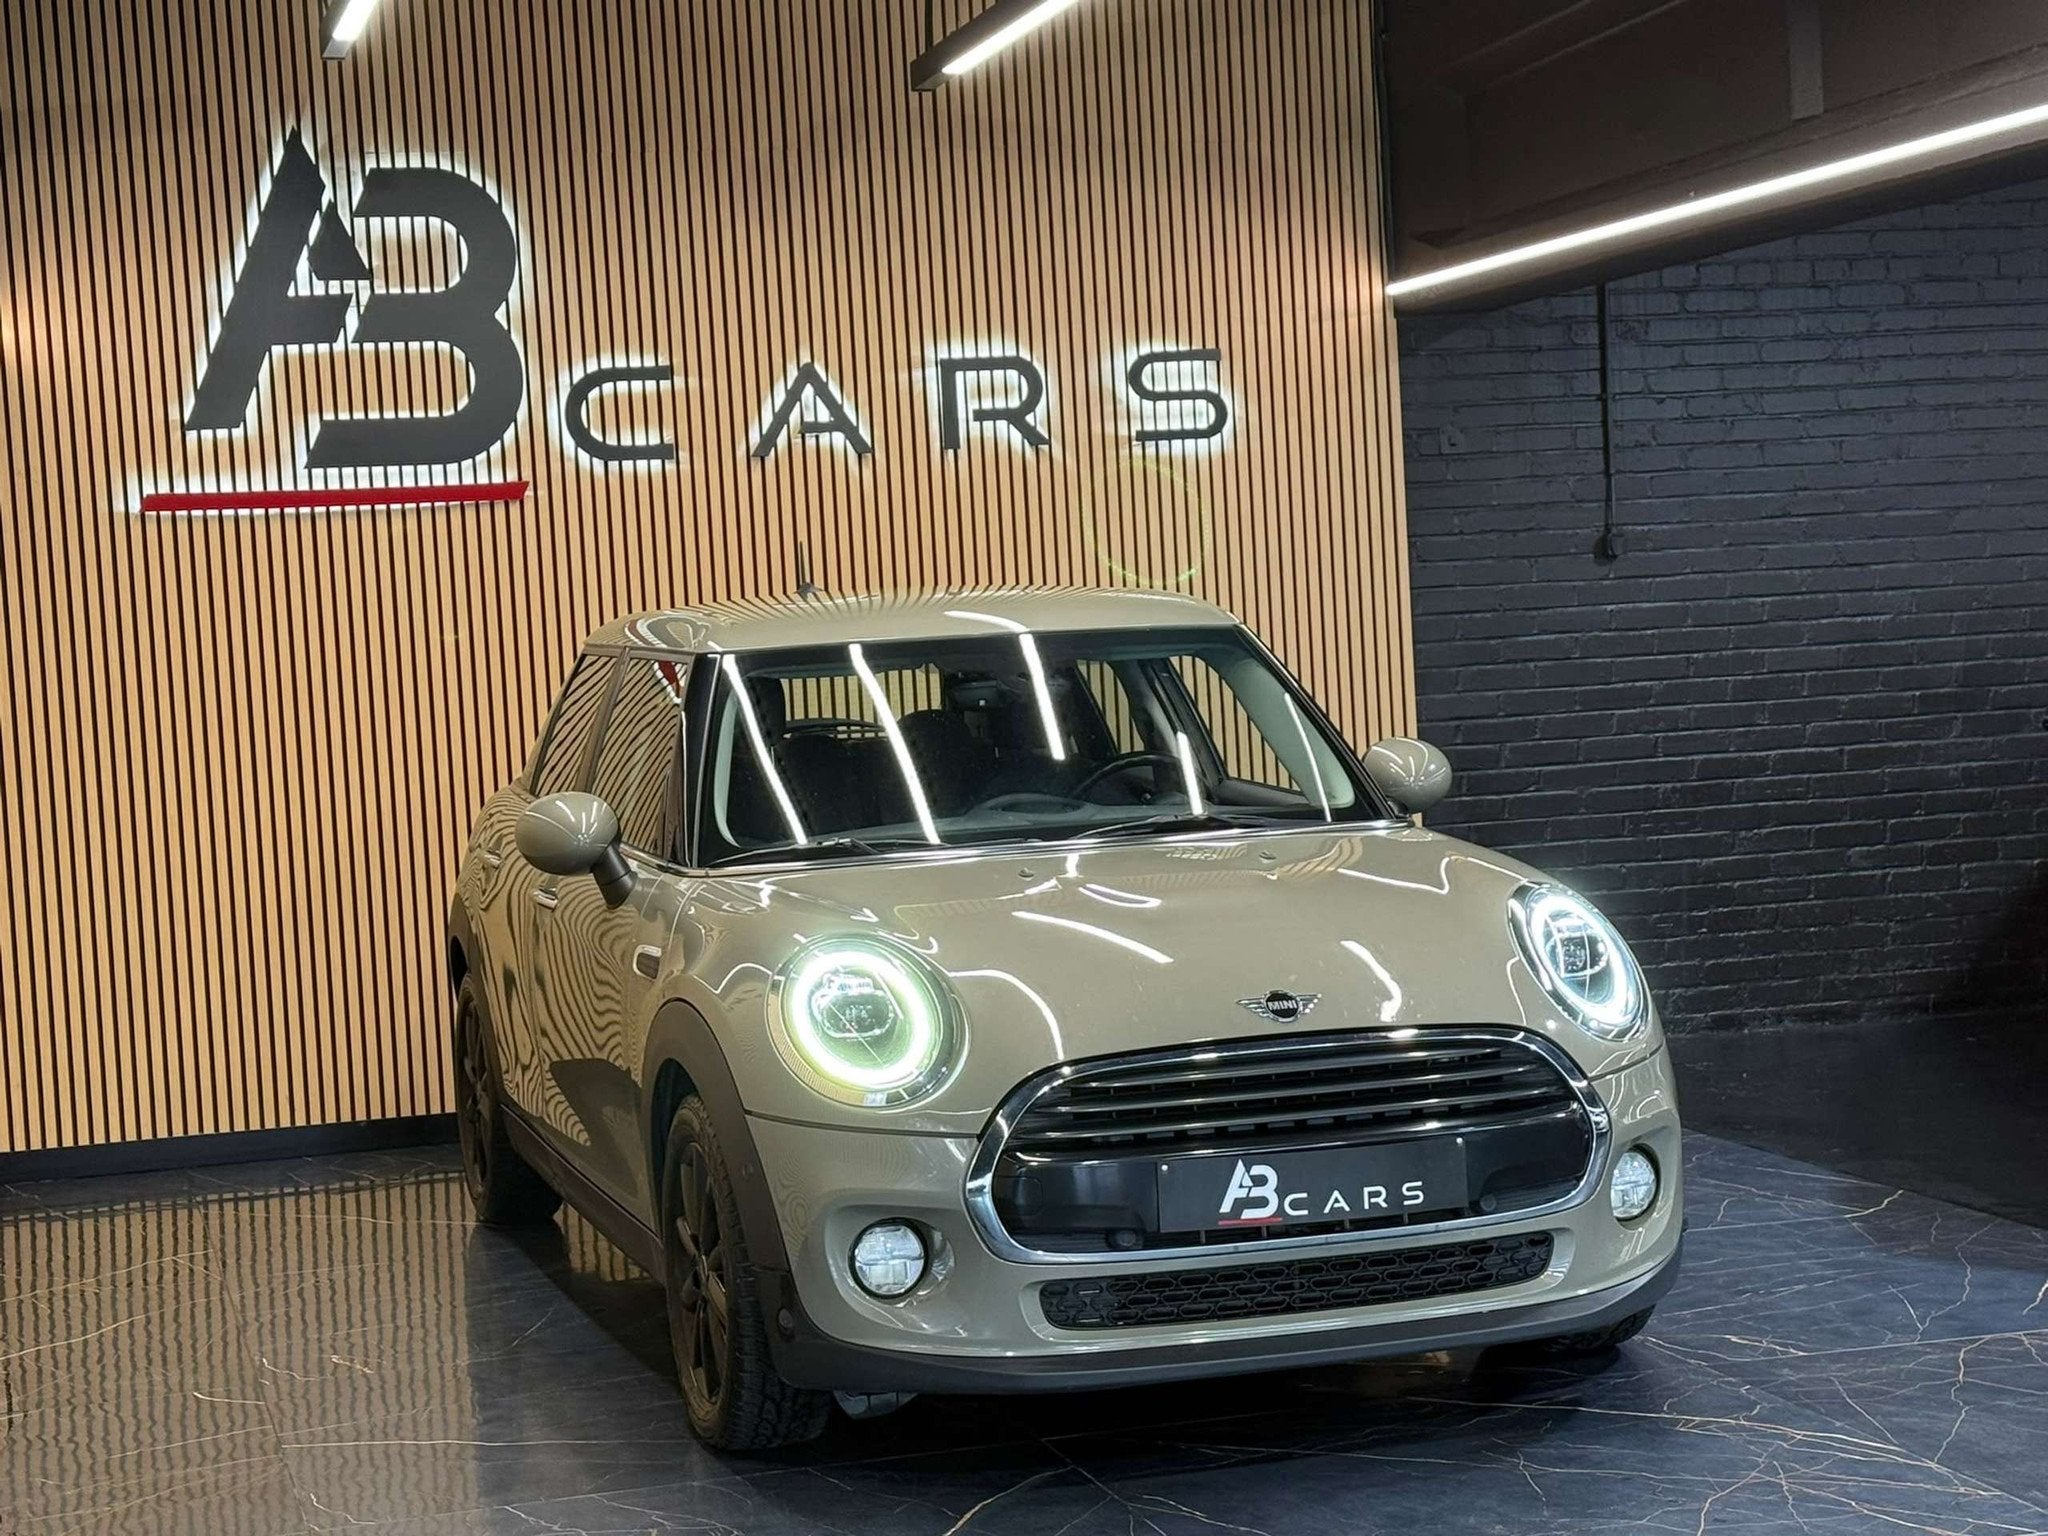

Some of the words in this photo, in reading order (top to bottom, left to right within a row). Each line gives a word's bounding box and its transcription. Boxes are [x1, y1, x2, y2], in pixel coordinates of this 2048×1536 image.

[184, 125, 524, 470] AB
[565, 348, 1229, 462] CARS
[1267, 1000, 1298, 1011] MINI
[1219, 1158, 1279, 1220] AB
[1283, 1180, 1424, 1216] CARS
